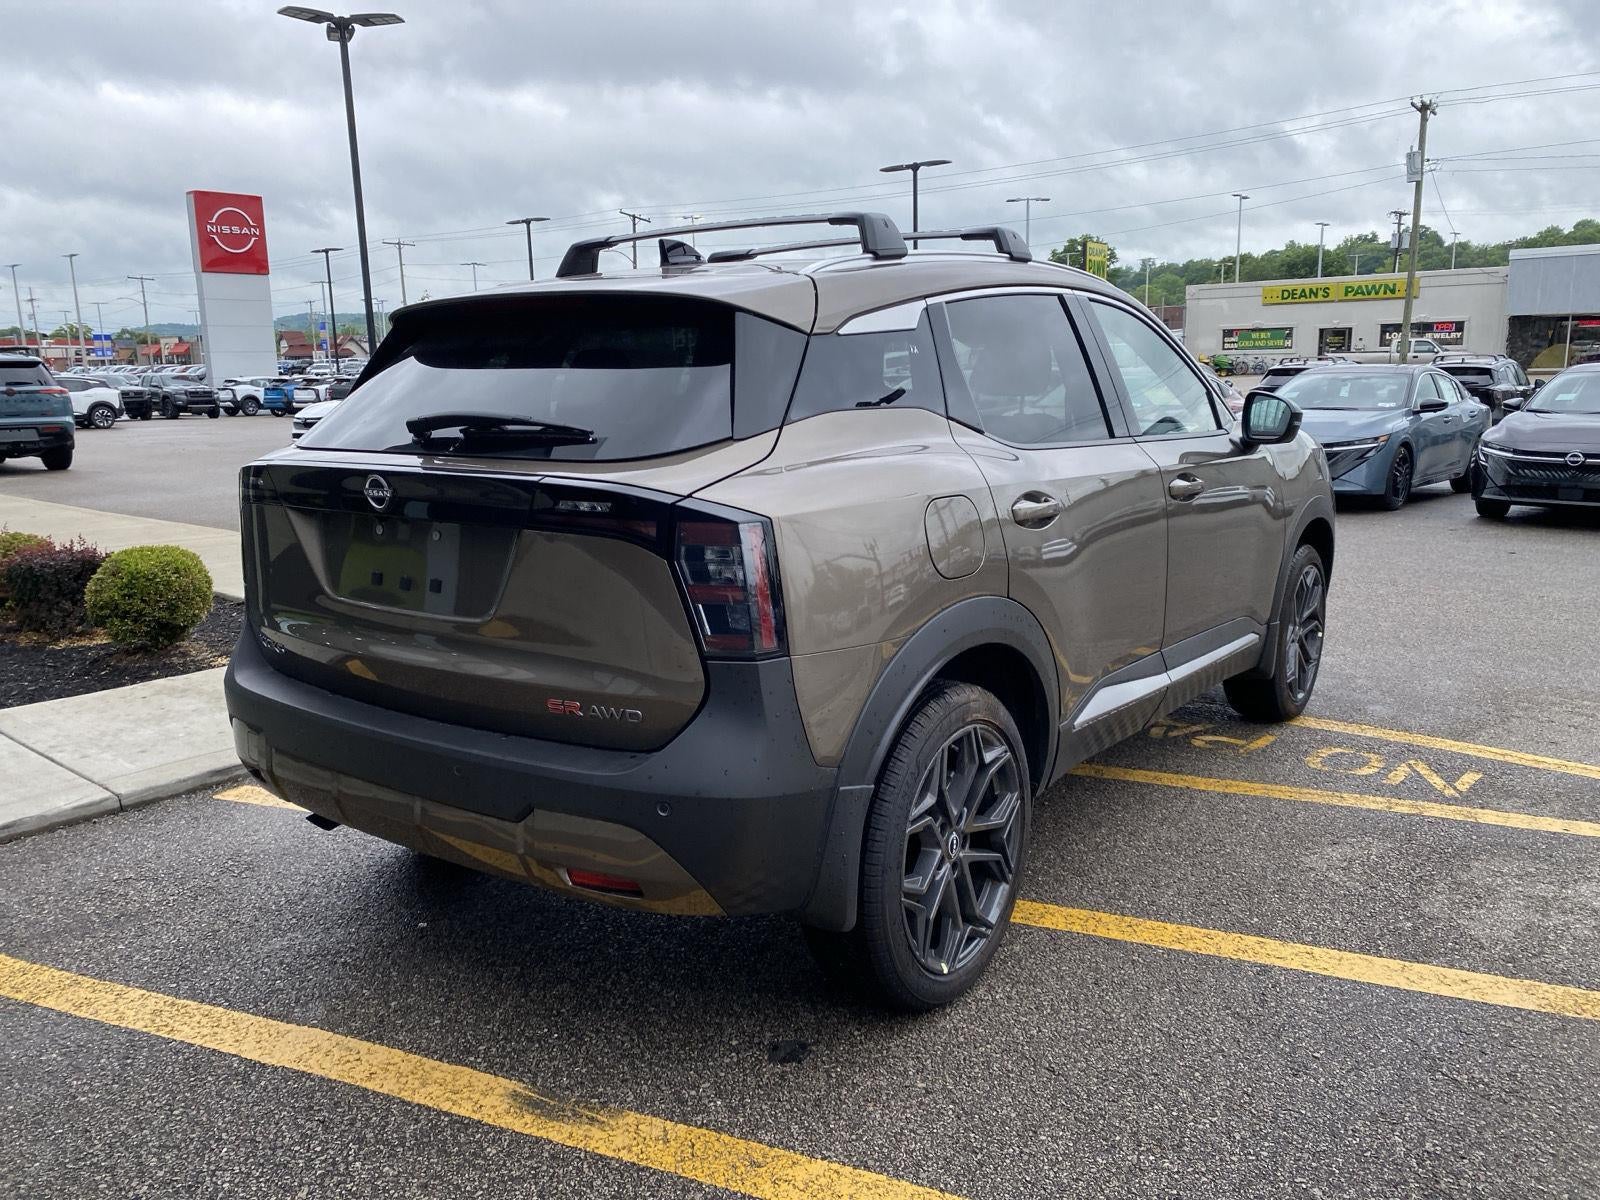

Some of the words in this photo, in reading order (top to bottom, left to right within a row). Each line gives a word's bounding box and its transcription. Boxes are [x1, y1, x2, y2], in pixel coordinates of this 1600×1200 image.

[206, 224, 260, 236] NISSAN
[545, 698, 584, 717] SR
[590, 704, 643, 722] AWD
[1304, 746, 1483, 798] NO
